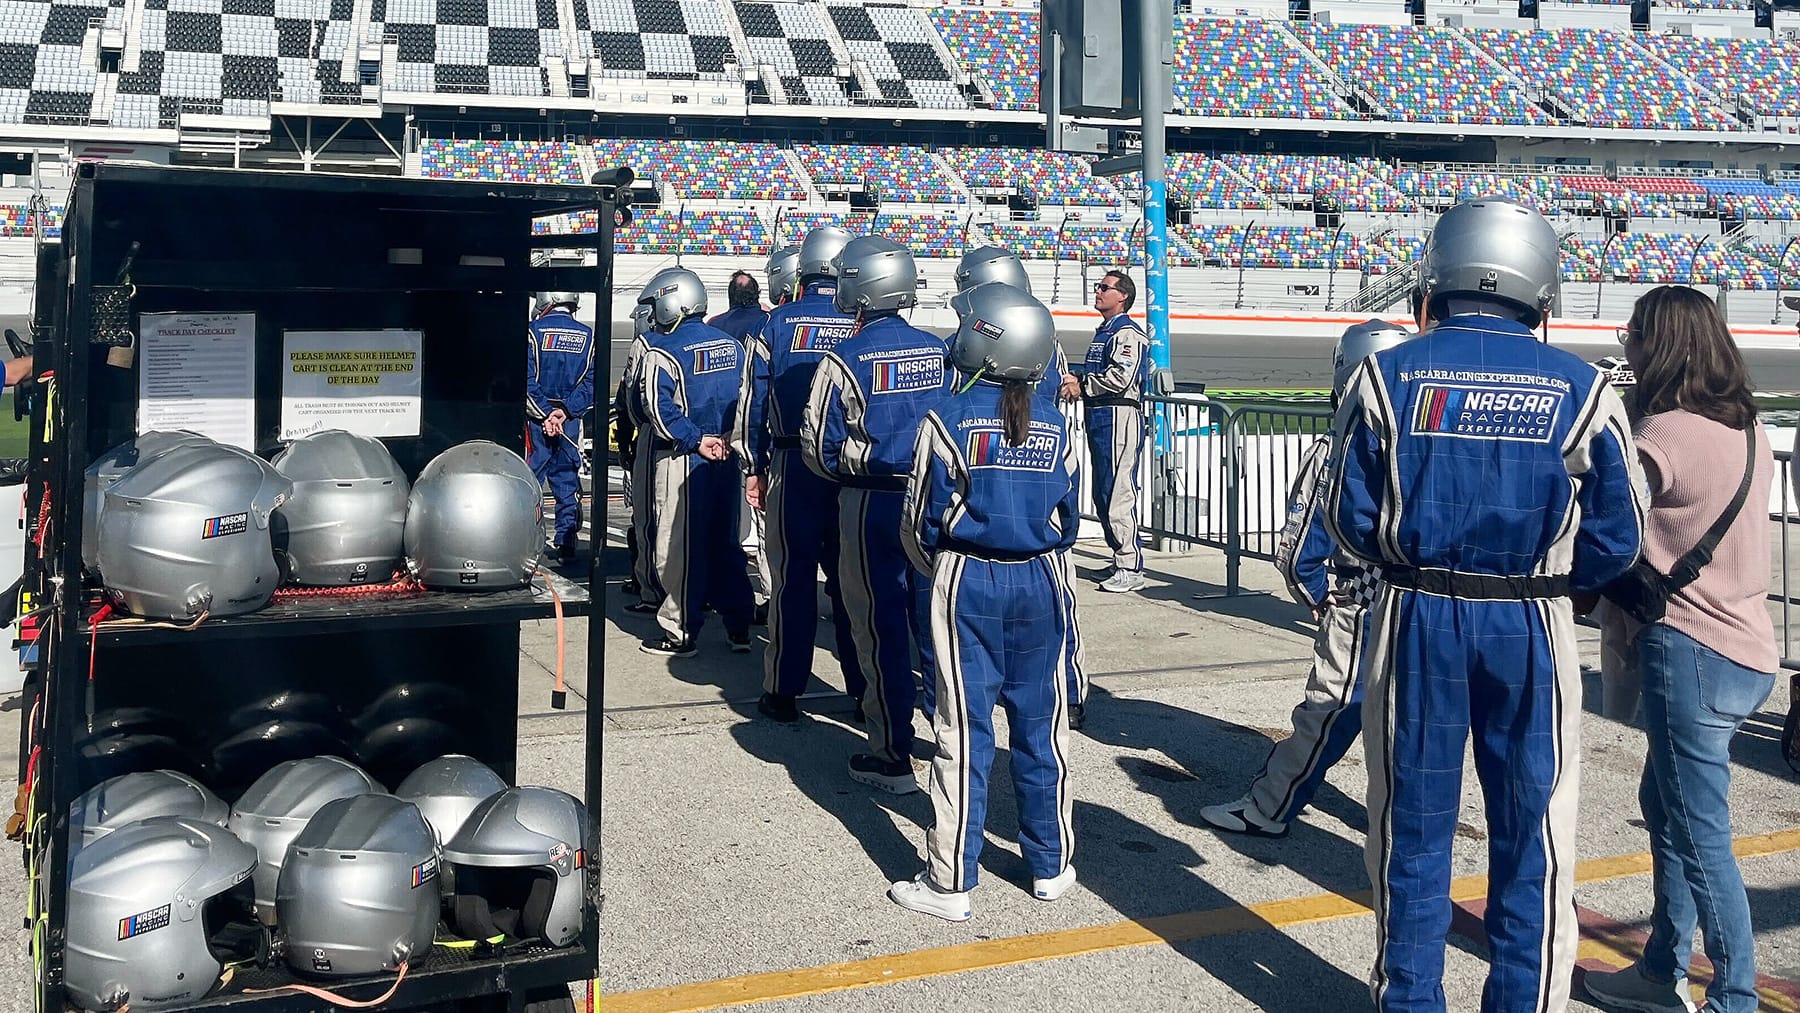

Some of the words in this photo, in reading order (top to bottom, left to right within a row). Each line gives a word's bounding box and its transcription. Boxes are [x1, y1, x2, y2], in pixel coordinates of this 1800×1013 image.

[1118, 139, 1142, 149] mus
[158, 328, 180, 337] TRACK
[197, 328, 237, 336] CHECKLIST
[817, 327, 854, 338] NASCA
[559, 335, 585, 344] NASCAR
[290, 351, 324, 361] PLEASE
[325, 351, 352, 360] MAKE
[353, 351, 377, 360] SURE
[379, 351, 417, 360] HELMET
[292, 364, 317, 373] CART
[319, 364, 328, 372] IS
[329, 363, 359, 372] CLEAN
[359, 363, 373, 372] AT
[374, 363, 393, 372] THE
[395, 363, 414, 372] END
[897, 359, 940, 375] NASCAR
[327, 376, 337, 385] OF
[340, 376, 360, 384] THE
[361, 375, 380, 384] DAY
[897, 371, 941, 382] RACING
[1399, 370, 1571, 393] NASCARRACINGEXPERIENCE.COM
[1463, 391, 1556, 415] NASCAR
[1460, 412, 1550, 425] RACING
[1457, 424, 1545, 436] EXPERIENCE
[999, 433, 1056, 452] NCAR
[998, 449, 1052, 460] RACING
[996, 457, 1050, 467] EXPERIENCE
[219, 513, 247, 526] NASCAR
[136, 906, 169, 924] NASCAR
[135, 915, 169, 930] RACING
